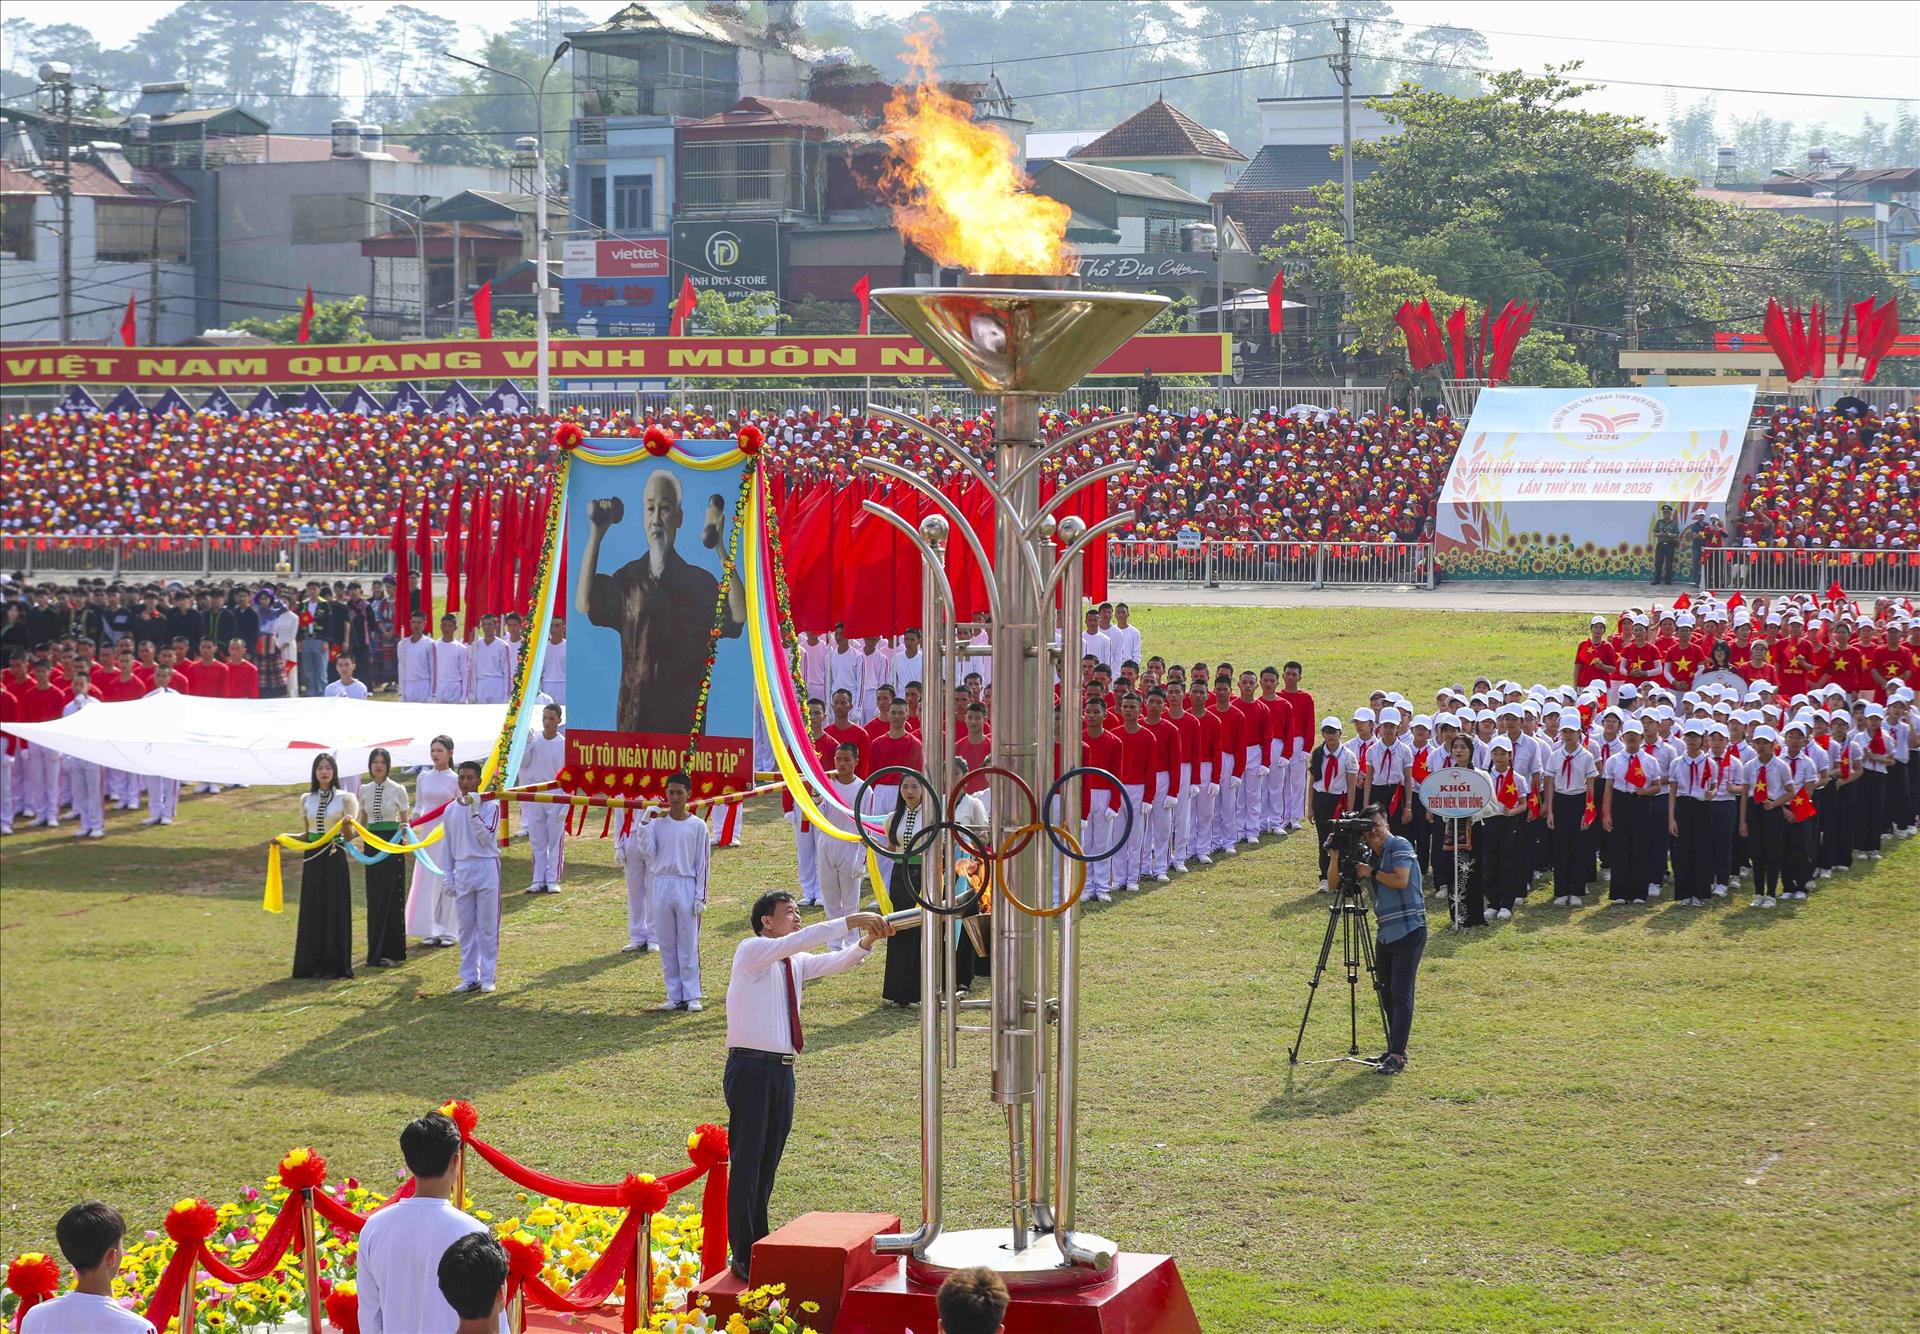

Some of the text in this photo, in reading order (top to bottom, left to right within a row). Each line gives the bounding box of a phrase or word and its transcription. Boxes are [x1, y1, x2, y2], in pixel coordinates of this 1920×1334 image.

[611, 248, 660, 260] viettel
[1115, 258, 1154, 280] Địa
[711, 275, 733, 286] DUY
[735, 275, 768, 285] STORE
[6, 355, 119, 378] VIỆT
[138, 358, 268, 376] NAM
[288, 351, 482, 376] QUANG
[502, 350, 645, 369] VINH
[668, 345, 857, 367] MUÔN
[1586, 433, 1619, 441] 2026
[1593, 460, 1624, 474] THAO
[1517, 478, 1542, 495] LẦN
[1544, 481, 1570, 494] THỨ
[1591, 480, 1622, 495] NĂM
[1623, 482, 1654, 494] 2026
[596, 742, 615, 767] TÔI
[618, 744, 649, 769] NGÀY
[652, 744, 677, 770] NÀO
[1440, 782, 1471, 792] KHỐI
[1428, 793, 1442, 808] THIẾU
